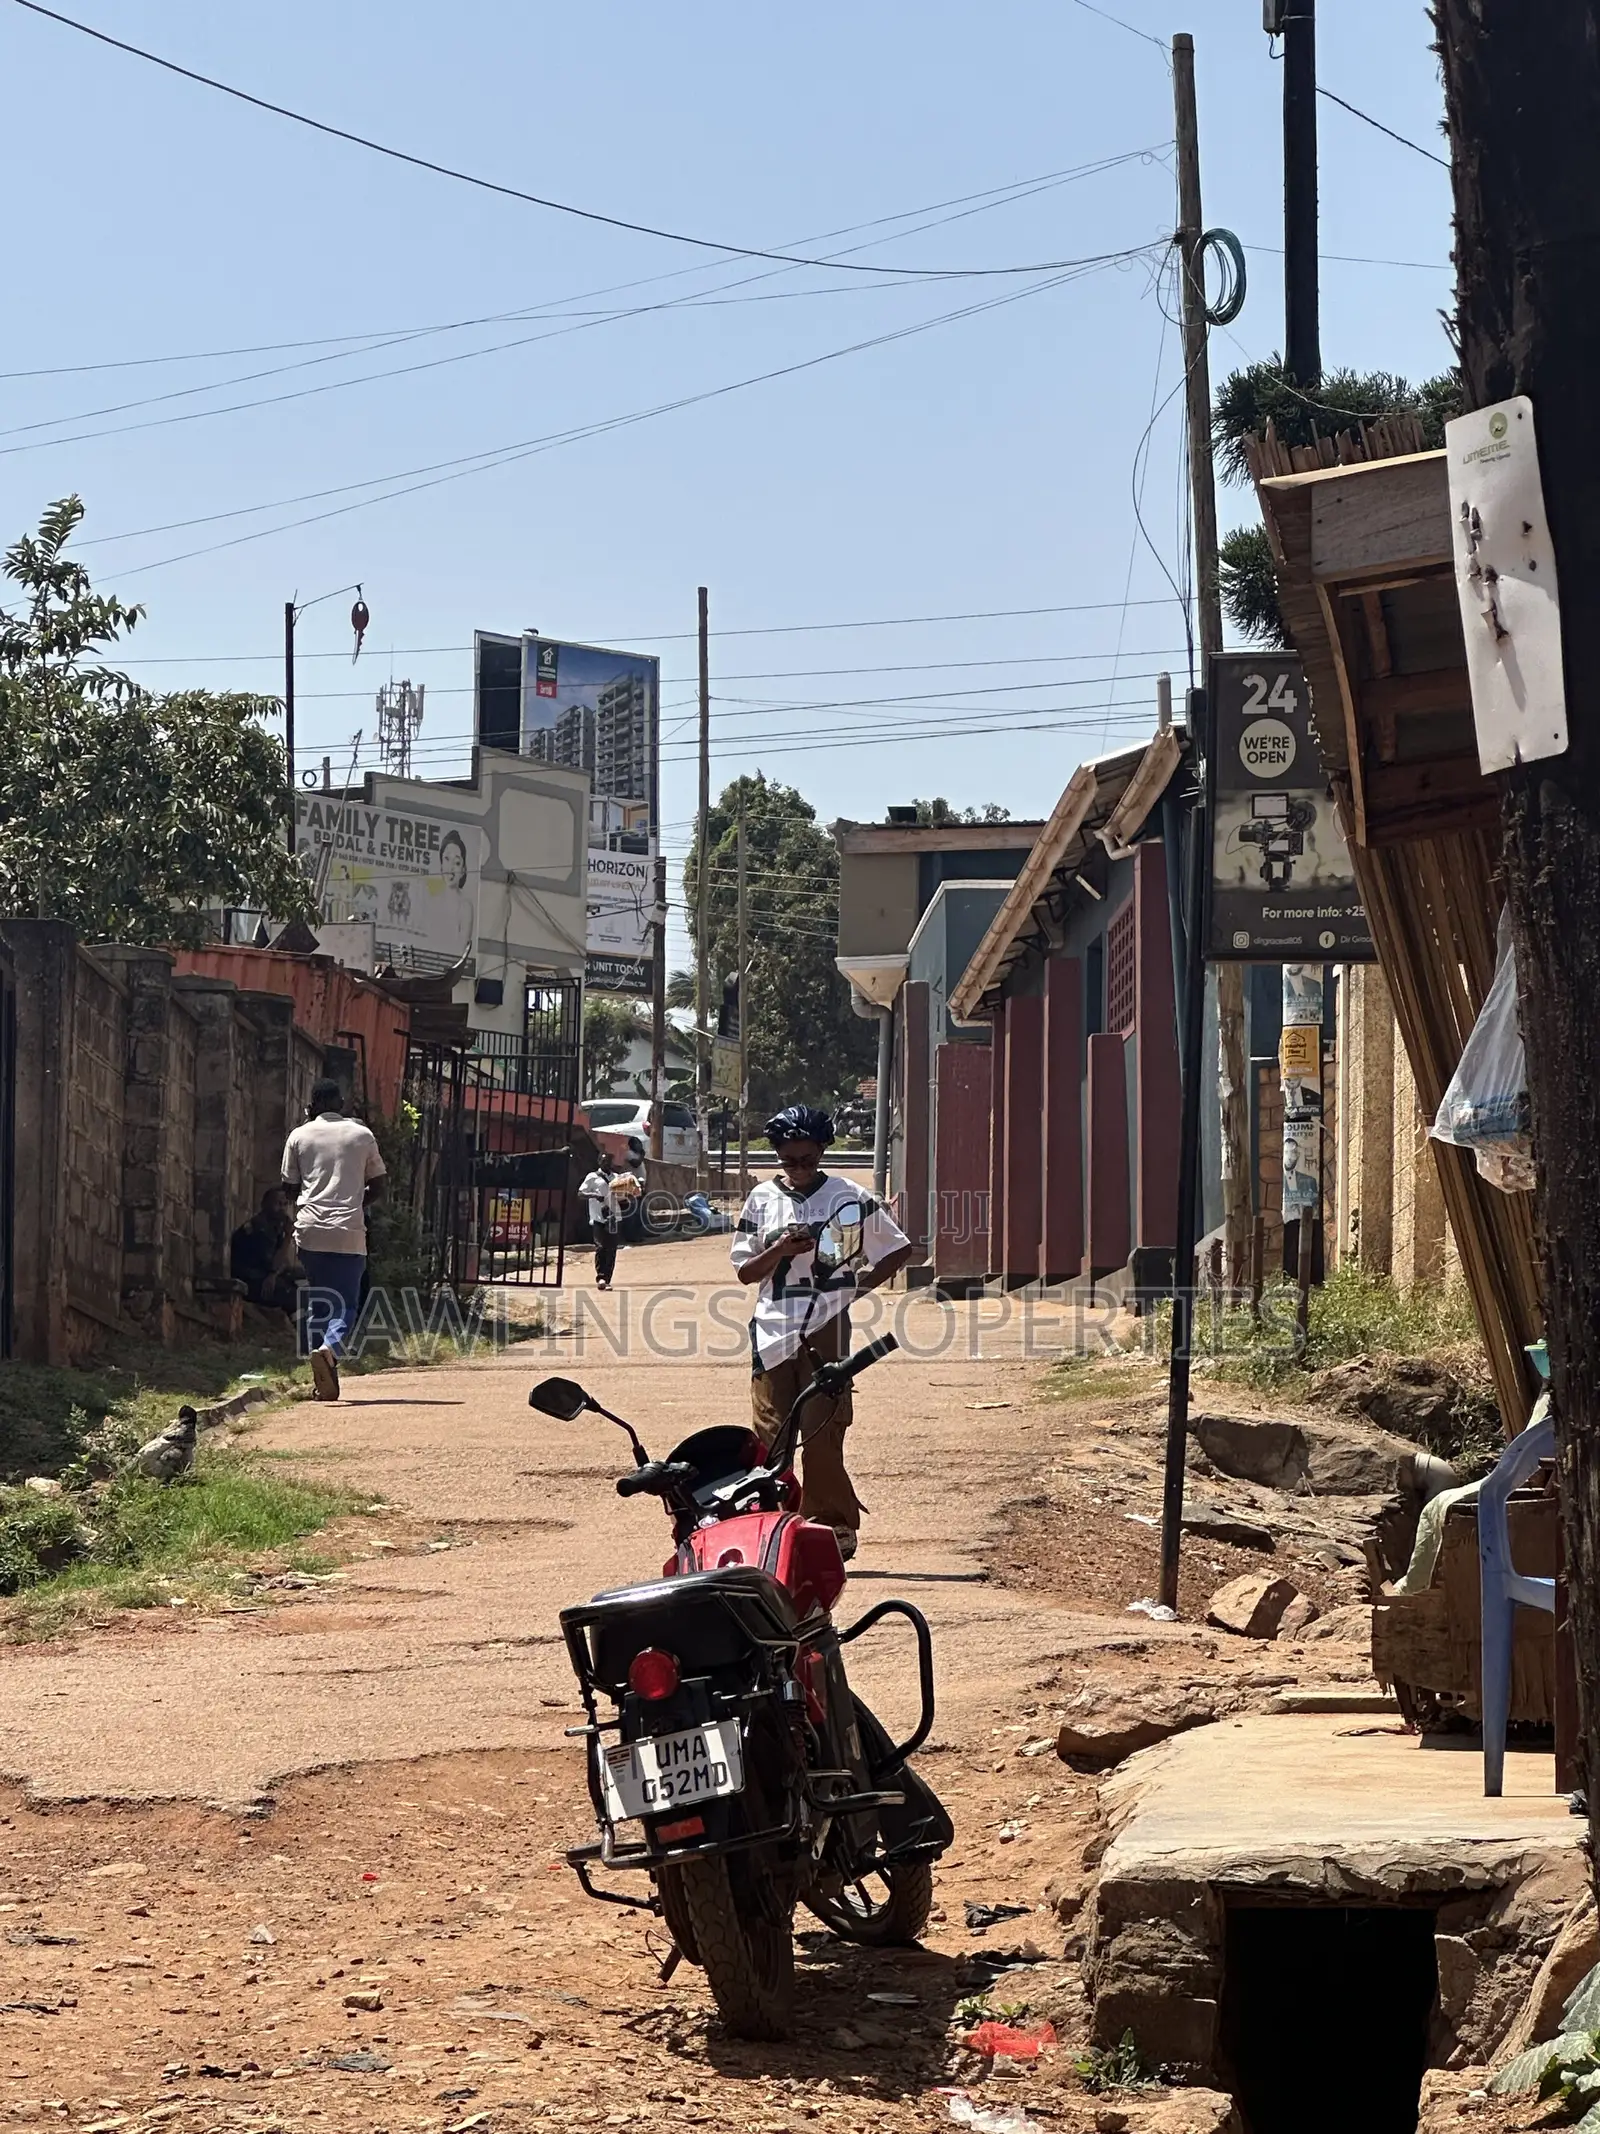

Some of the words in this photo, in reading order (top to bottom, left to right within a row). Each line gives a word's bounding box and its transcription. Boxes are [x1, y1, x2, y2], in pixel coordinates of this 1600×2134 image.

[1242, 674, 1298, 714] 24
[1243, 735, 1290, 750] WE'RE
[1246, 750, 1287, 764] OPEN
[295, 798, 381, 839] FAMILY
[385, 815, 441, 852] TREE
[366, 840, 377, 856] &
[380, 841, 431, 866] EVENTS
[588, 858, 645, 878] HORIZON
[1262, 907, 1281, 918] For
[1283, 908, 1315, 918] more
[1317, 906, 1343, 917] info:
[1345, 905, 1366, 917] +25
[614, 963, 645, 976] TODAY
[655, 1735, 707, 1769] UMA
